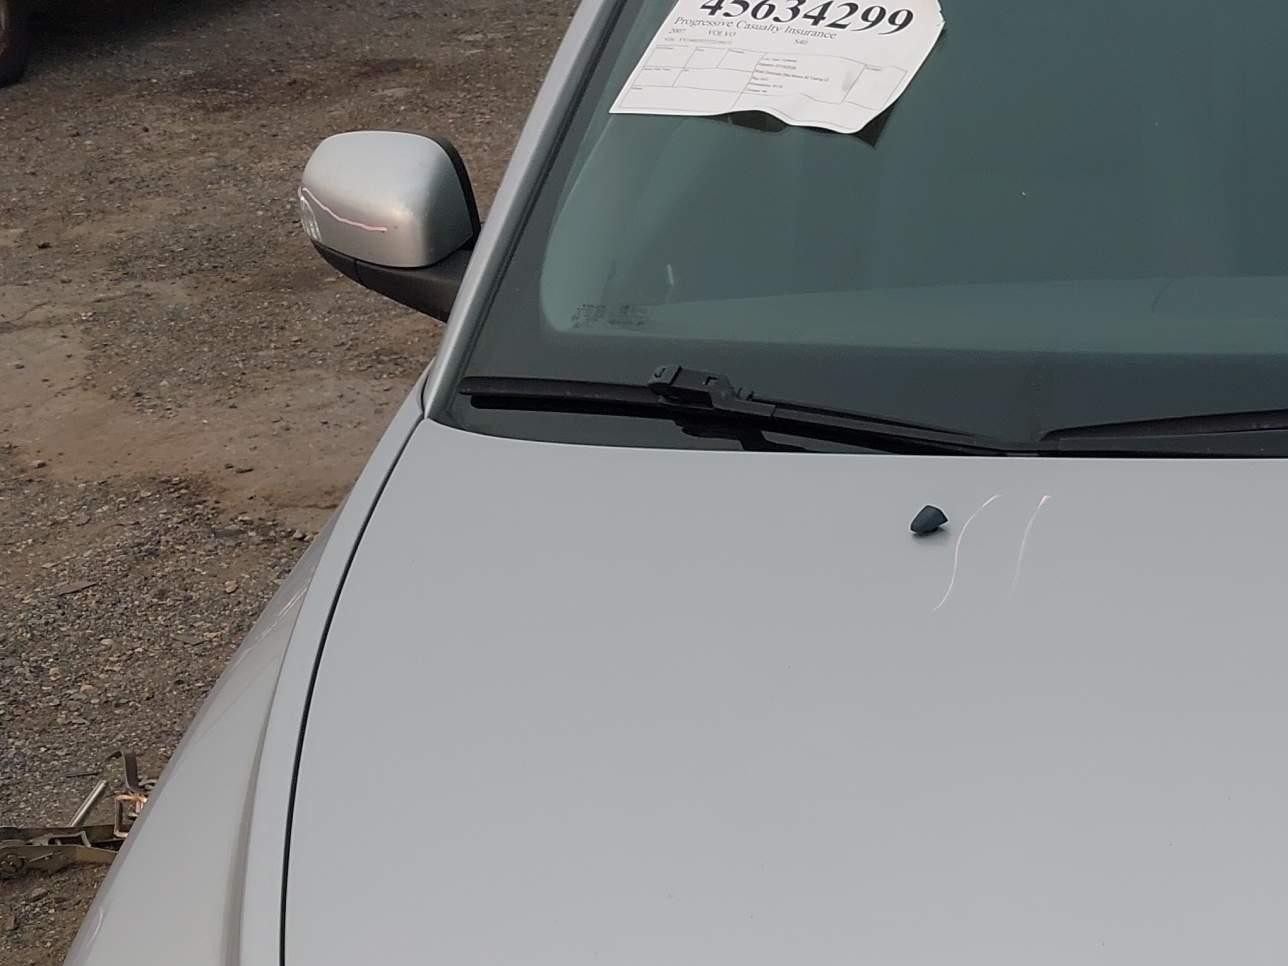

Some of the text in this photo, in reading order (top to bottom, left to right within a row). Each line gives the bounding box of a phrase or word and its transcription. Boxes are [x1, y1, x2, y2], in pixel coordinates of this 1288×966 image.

[674, 16, 837, 40] Progressive Casualty Insurance
[700, 0, 914, 35] 45634299
